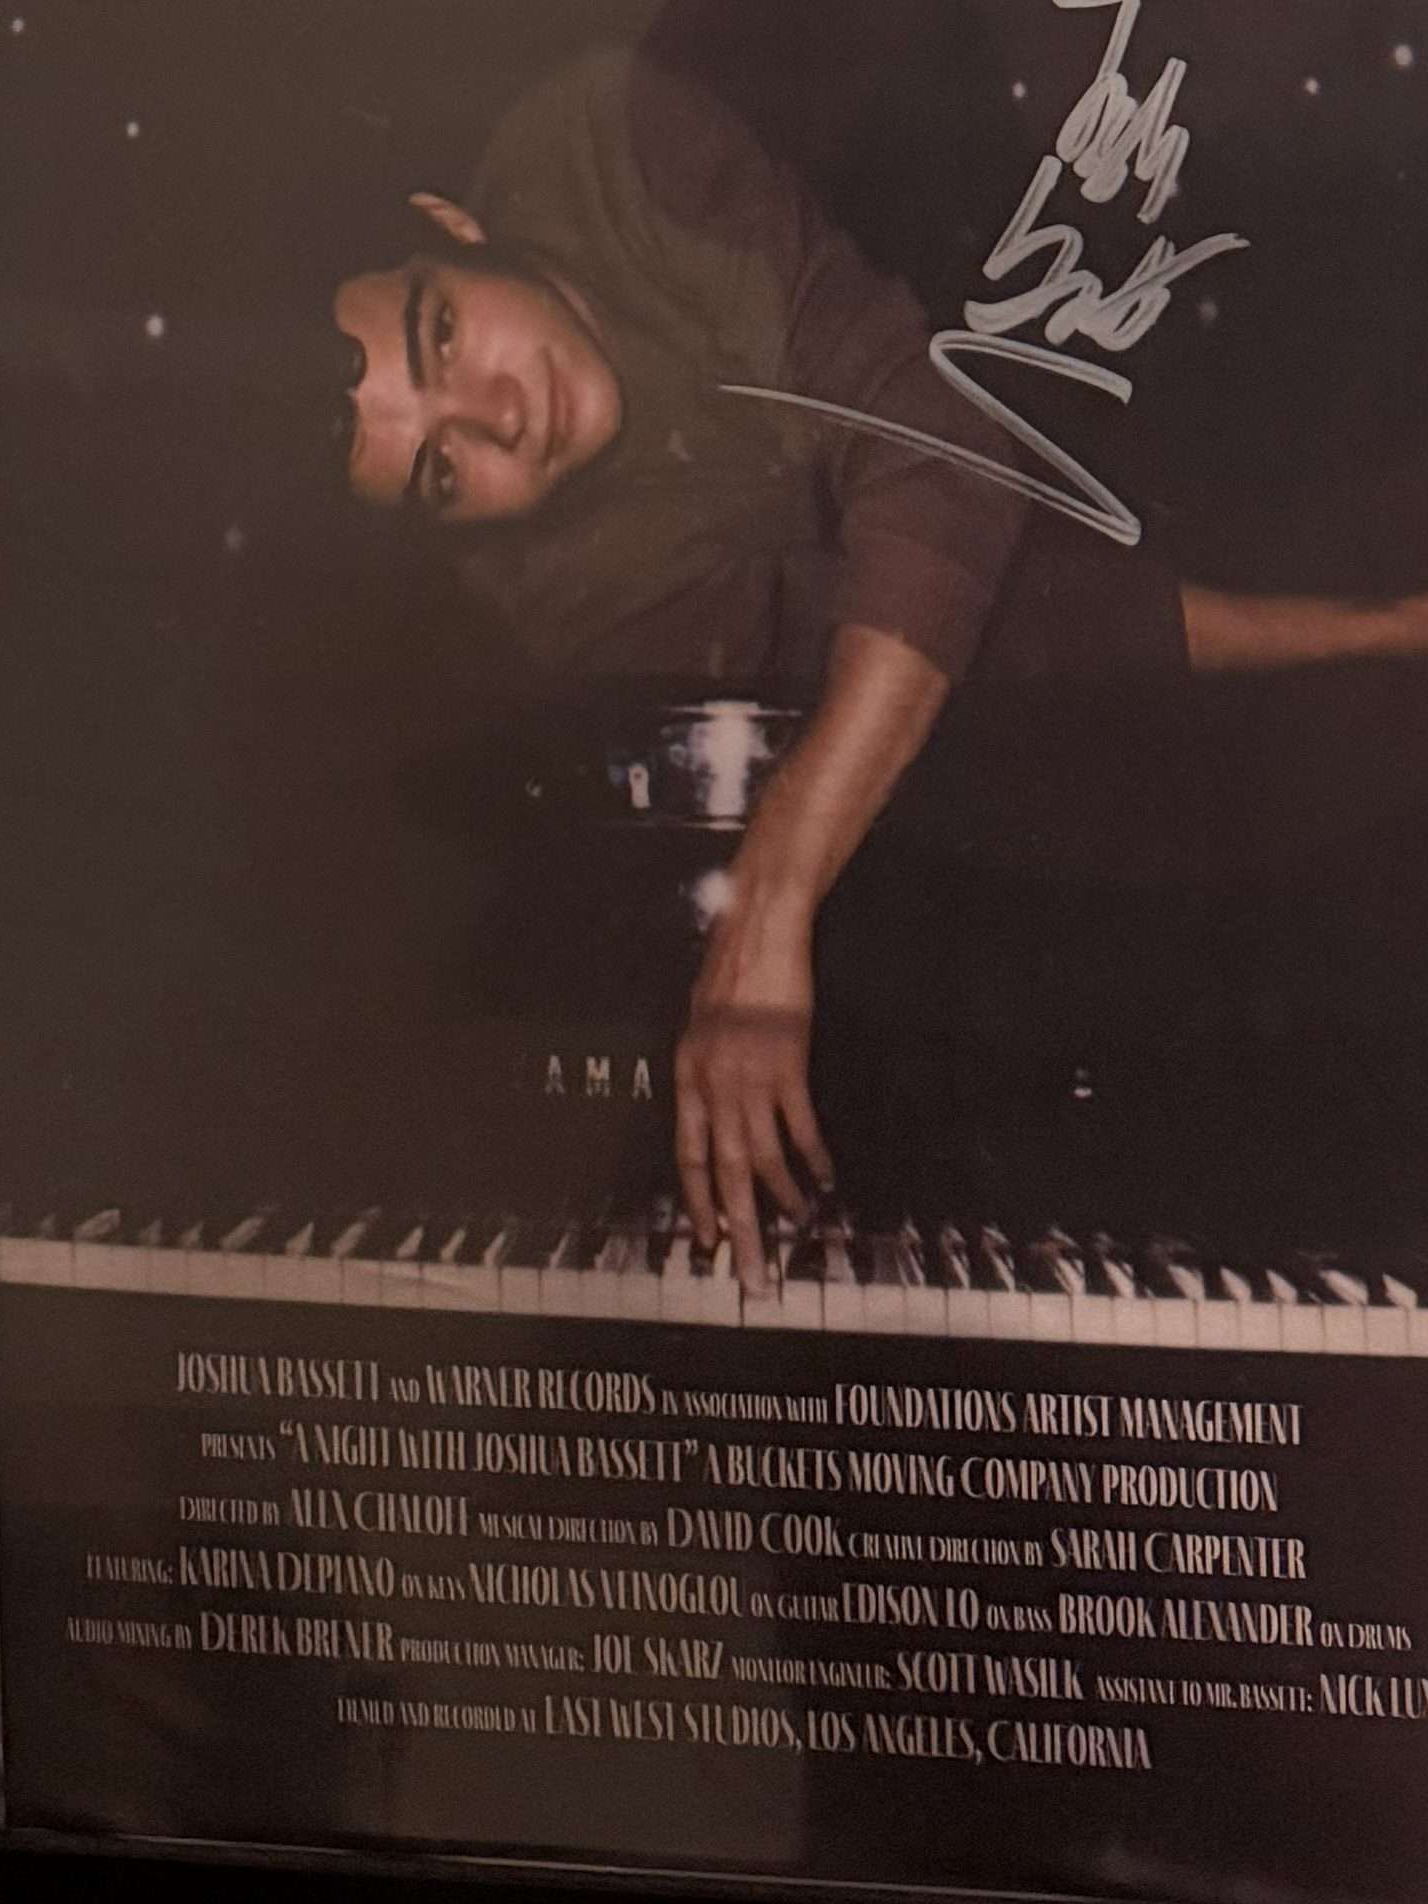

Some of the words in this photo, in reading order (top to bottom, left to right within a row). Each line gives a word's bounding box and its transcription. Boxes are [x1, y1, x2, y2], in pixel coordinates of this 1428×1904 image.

[177, 1352, 271, 1395] JOSHUA
[277, 1357, 379, 1401] BASSETT
[426, 1365, 532, 1409] WARNER
[538, 1368, 655, 1414] RECORDS
[786, 1396, 828, 1424] WITH
[835, 1383, 1017, 1433] FOUNDATIONS
[1024, 1393, 1113, 1436] ARTIST
[1120, 1396, 1304, 1445] MANAGEMENT
[314, 1424, 390, 1467] NIGHT
[399, 1427, 465, 1471] WITH
[473, 1432, 571, 1477] JOSHUA
[704, 1443, 721, 1484] A
[727, 1445, 842, 1492] BUCKETS
[849, 1450, 955, 1497] MOVING
[960, 1456, 1095, 1504] COMPANY
[1103, 1463, 1278, 1512] PRODUCTION
[807, 1710, 855, 1752] LOS
[866, 1714, 982, 1765] ANGELES,
[988, 1720, 1152, 1769] CALIFORNIA
